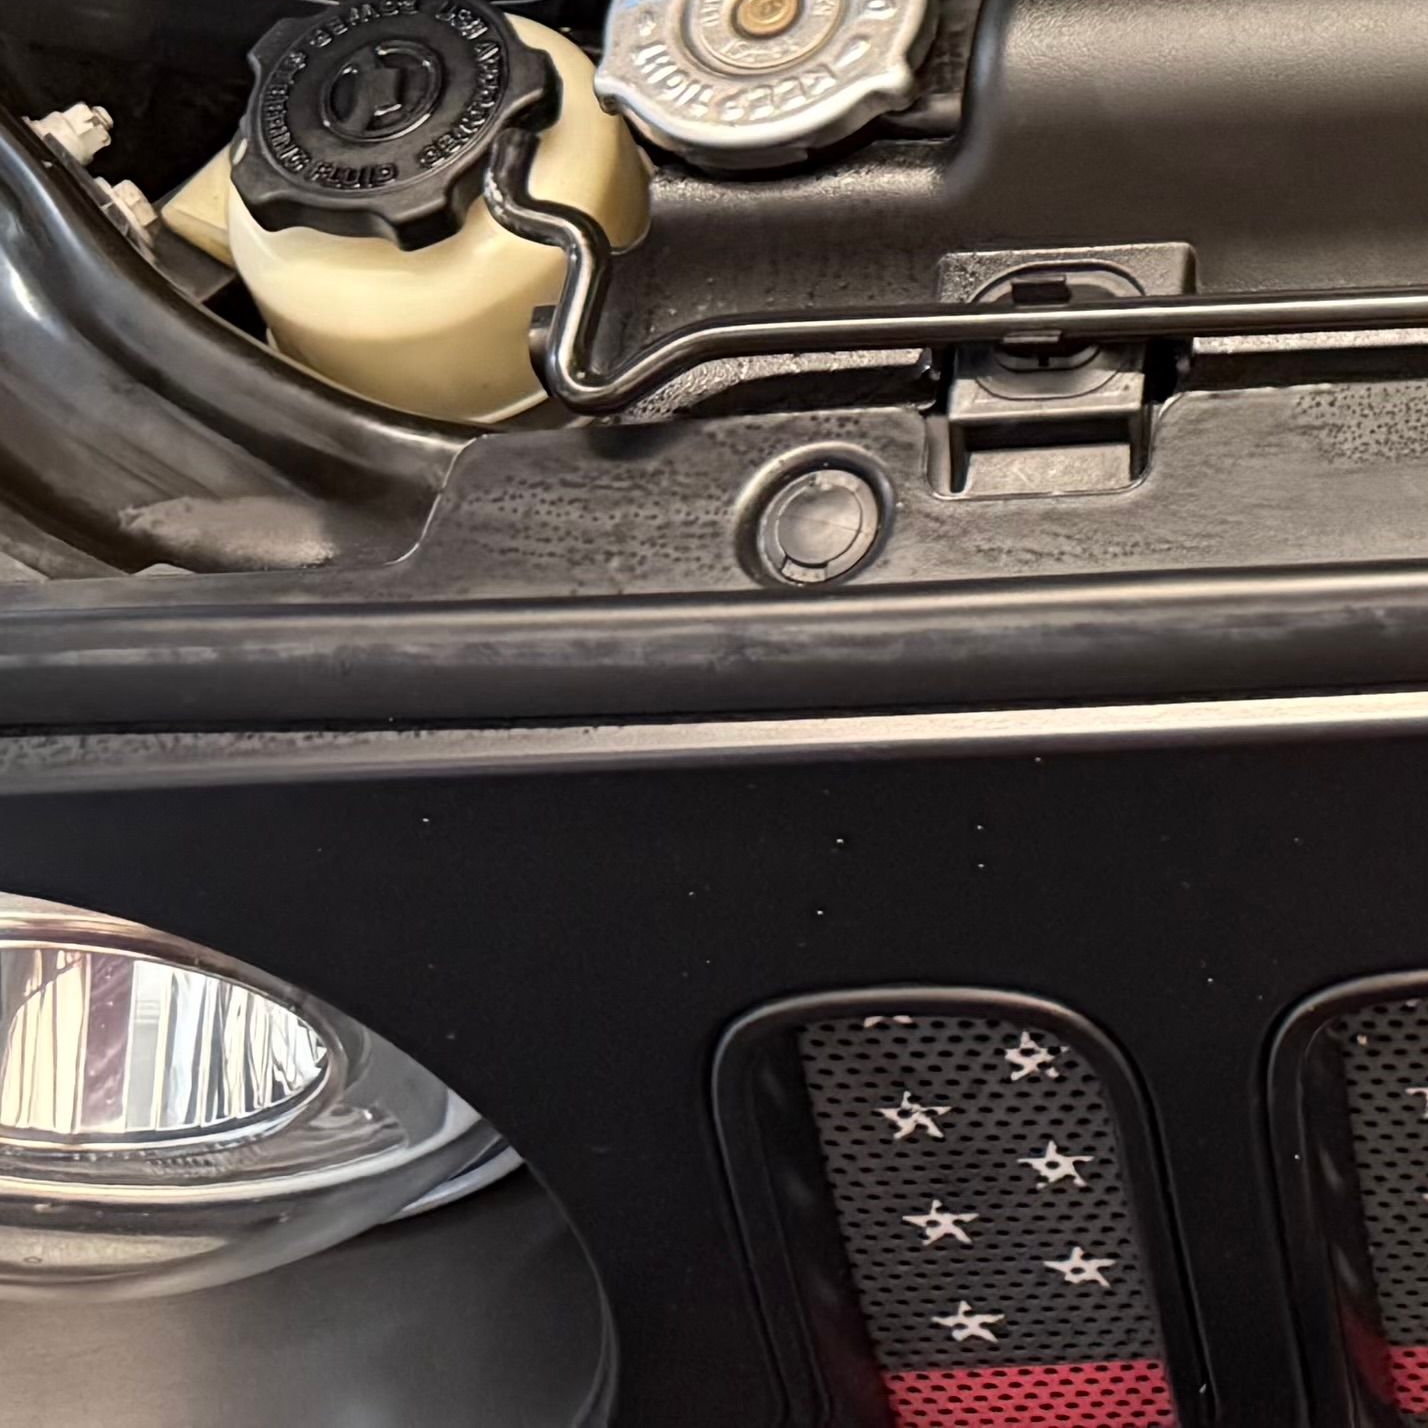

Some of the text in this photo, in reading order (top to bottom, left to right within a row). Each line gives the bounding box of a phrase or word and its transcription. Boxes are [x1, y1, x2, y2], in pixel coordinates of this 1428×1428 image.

[632, 44, 838, 122] KEEP TIGHT
[311, 160, 398, 189] FLUID
